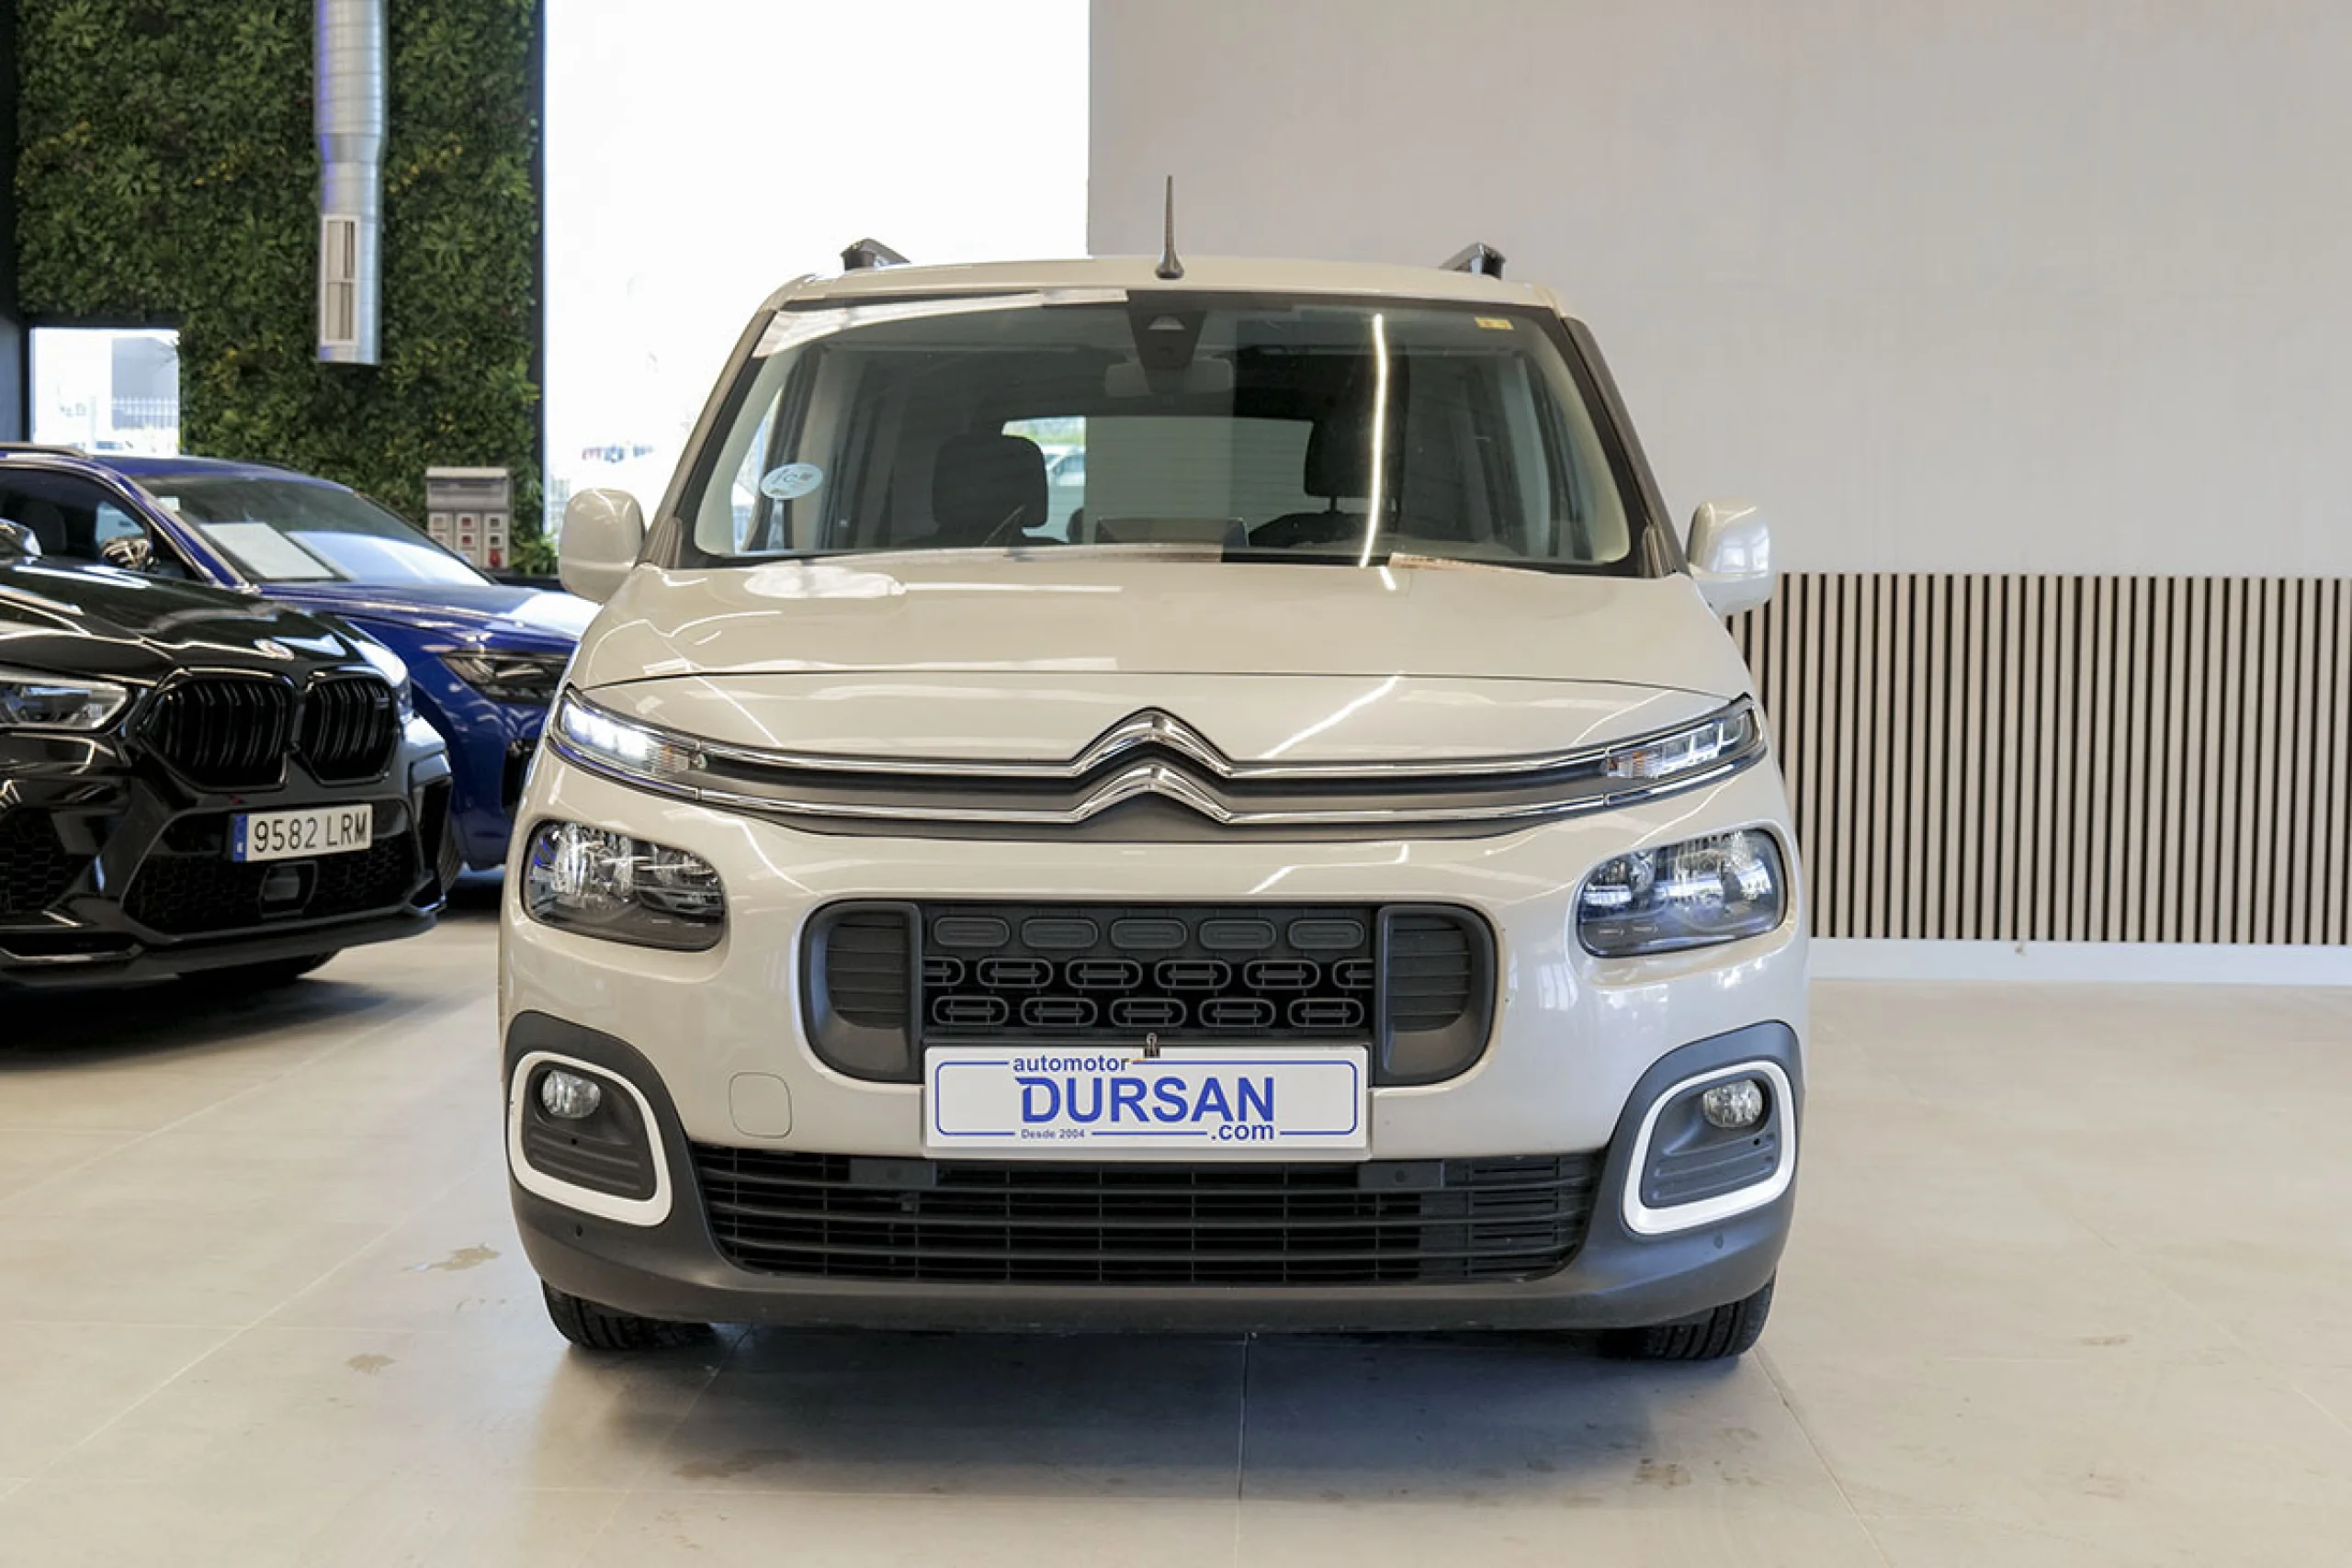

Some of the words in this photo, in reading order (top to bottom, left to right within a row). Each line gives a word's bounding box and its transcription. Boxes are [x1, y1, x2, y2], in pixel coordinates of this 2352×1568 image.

[254, 817, 319, 852] 9582
[326, 812, 368, 847] LRM
[1012, 1055, 1130, 1072] automotor
[1014, 1077, 1274, 1122] DURSAN
[1021, 1128, 1056, 1139] Desde
[1059, 1128, 1085, 1139] 2004
[1210, 1122, 1274, 1141] .com
